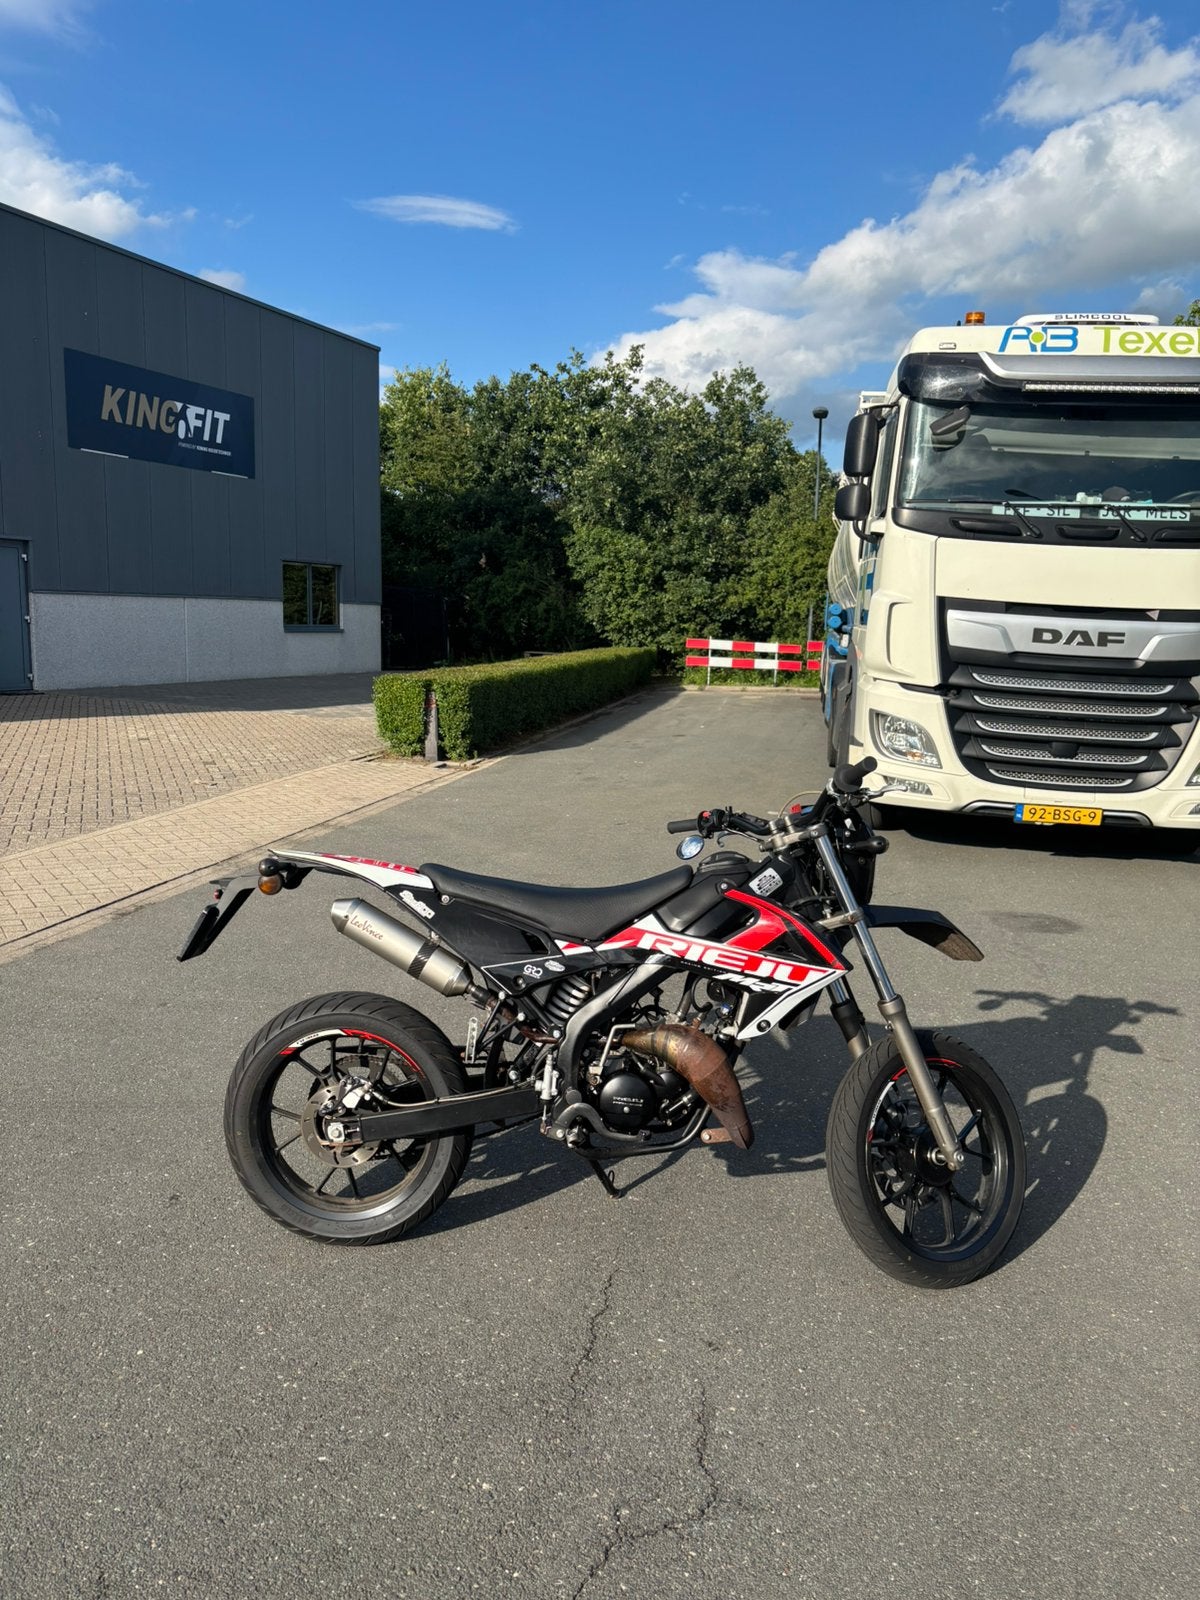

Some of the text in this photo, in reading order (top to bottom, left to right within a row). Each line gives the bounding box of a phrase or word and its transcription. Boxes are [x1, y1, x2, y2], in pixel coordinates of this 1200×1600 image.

[1054, 313, 1132, 321] SLIMCOOL
[1031, 627, 1126, 648] DAF
[1028, 807, 1097, 823] 92-BSG-9
[350, 914, 384, 941] LeoVince
[636, 931, 829, 984] RIEJU
